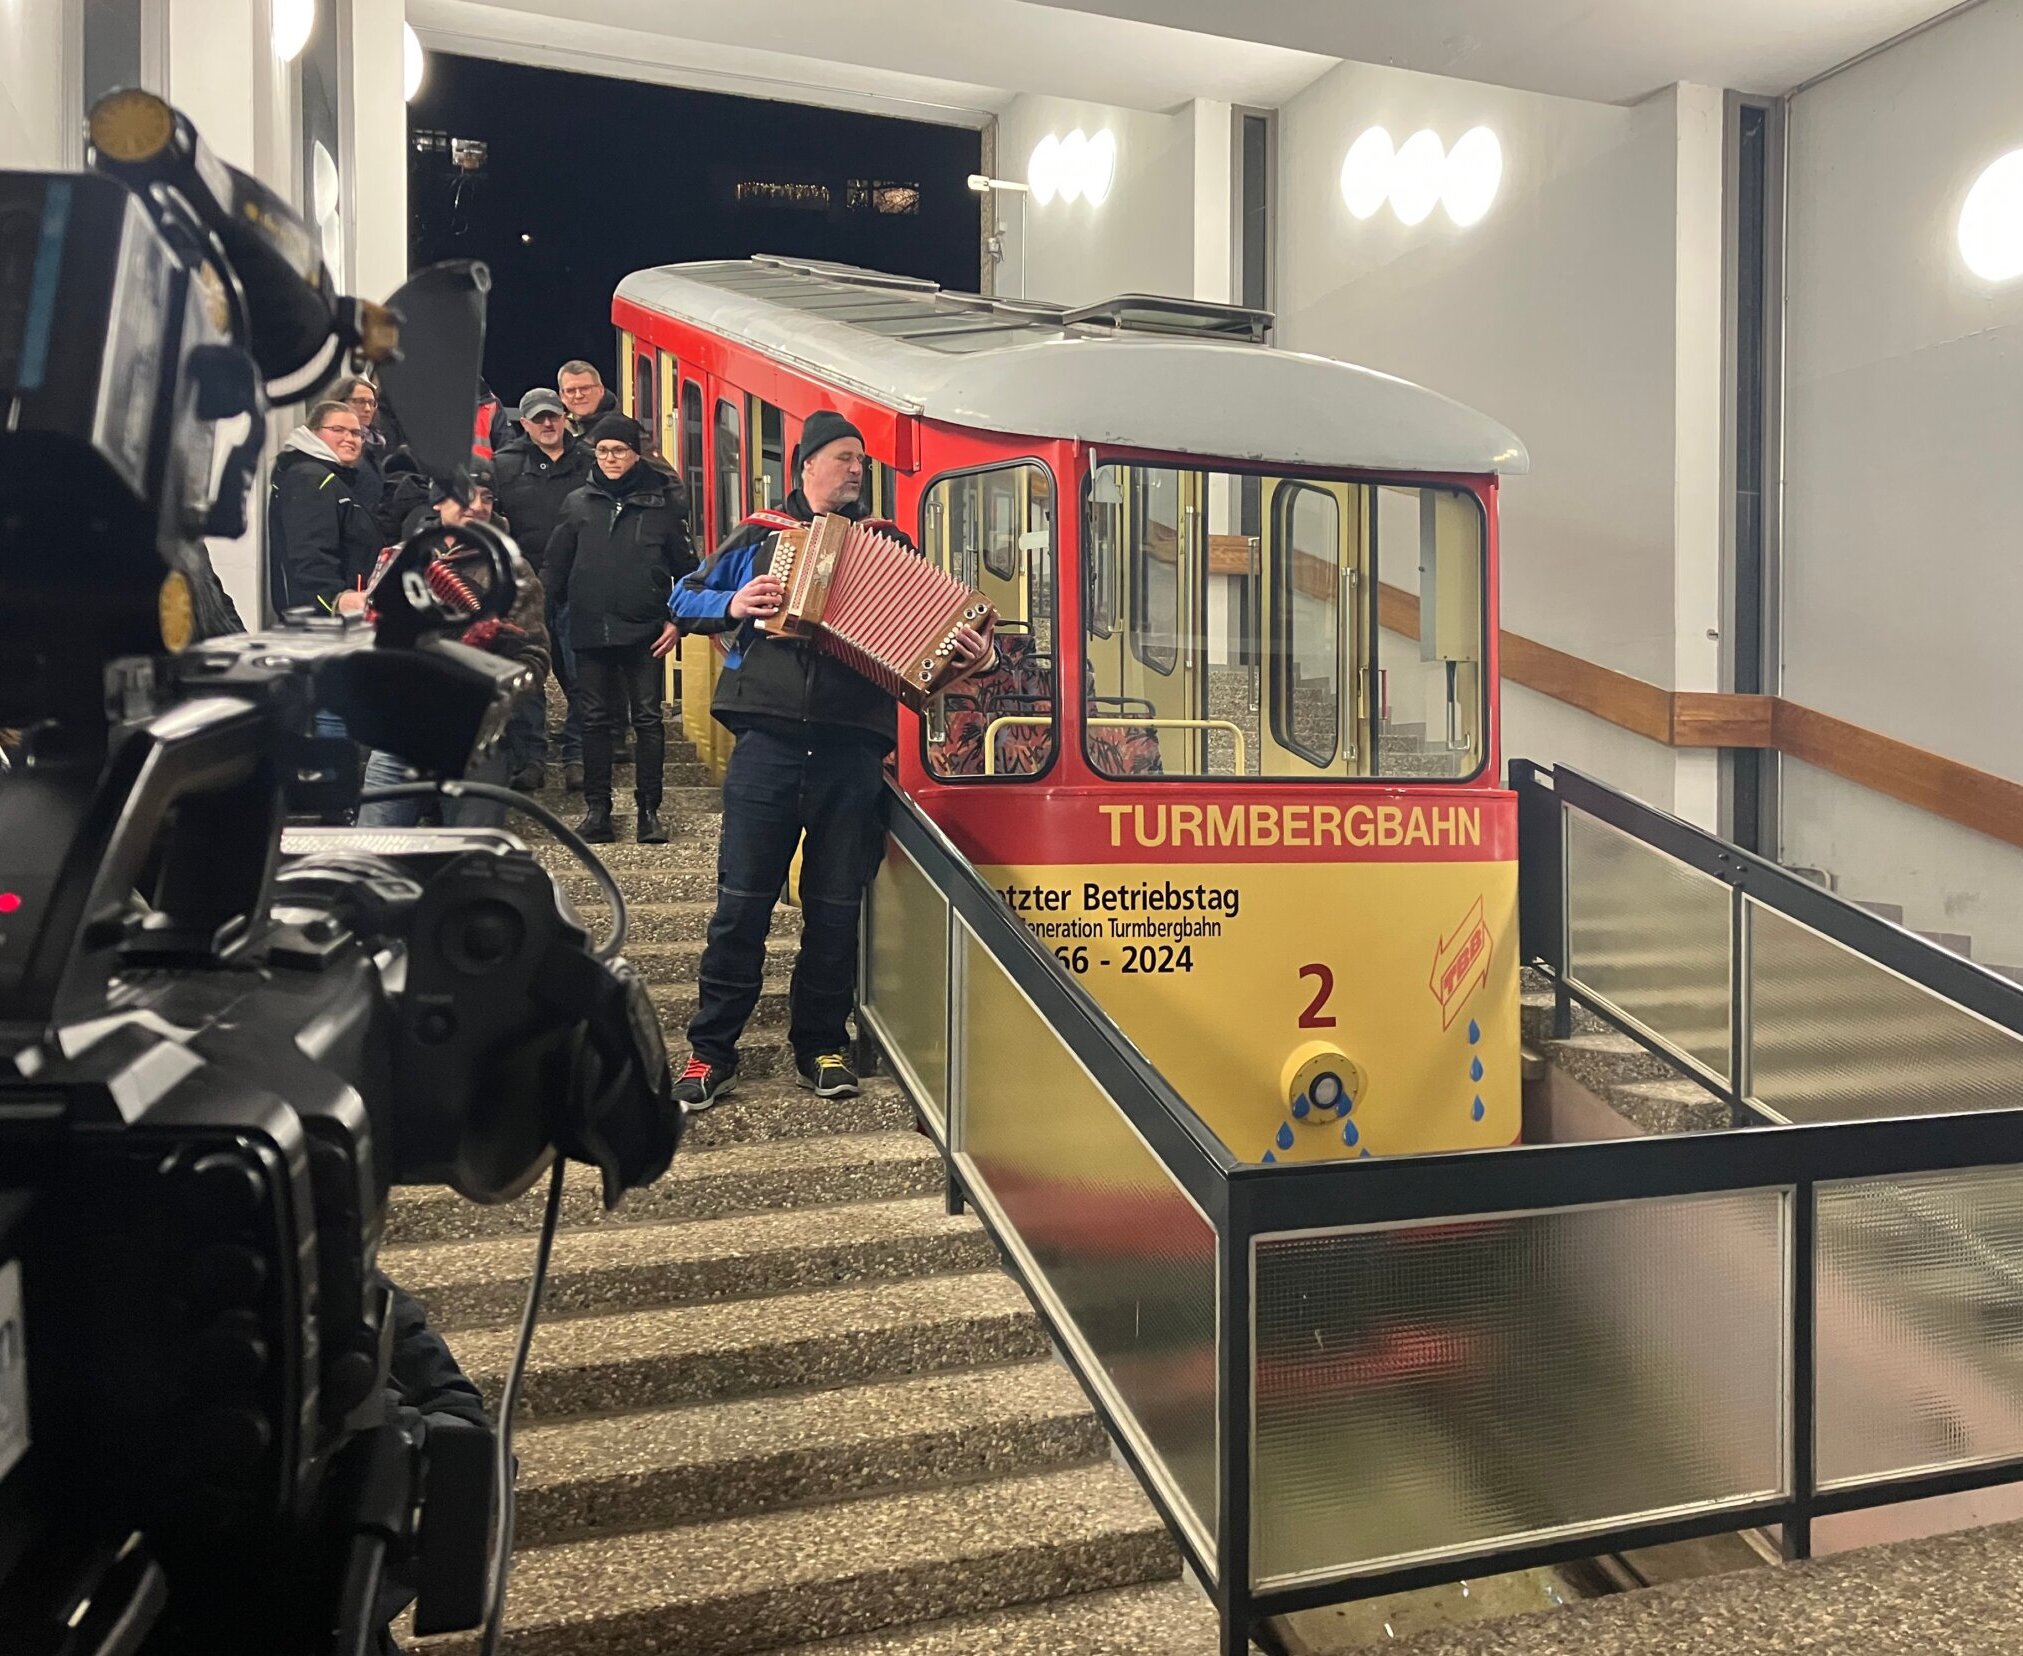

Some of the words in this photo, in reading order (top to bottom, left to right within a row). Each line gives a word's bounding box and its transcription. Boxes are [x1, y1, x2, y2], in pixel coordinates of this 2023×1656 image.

[1098, 804, 1481, 847] TURMBERGBAHN
[1083, 881, 1239, 918] Betriebstag
[1023, 917, 1103, 938] eneration
[1107, 916, 1222, 943] Turmbergbahn
[1121, 945, 1194, 974] 2024
[1443, 927, 1483, 996] TBB
[1298, 963, 1337, 1029] 2
